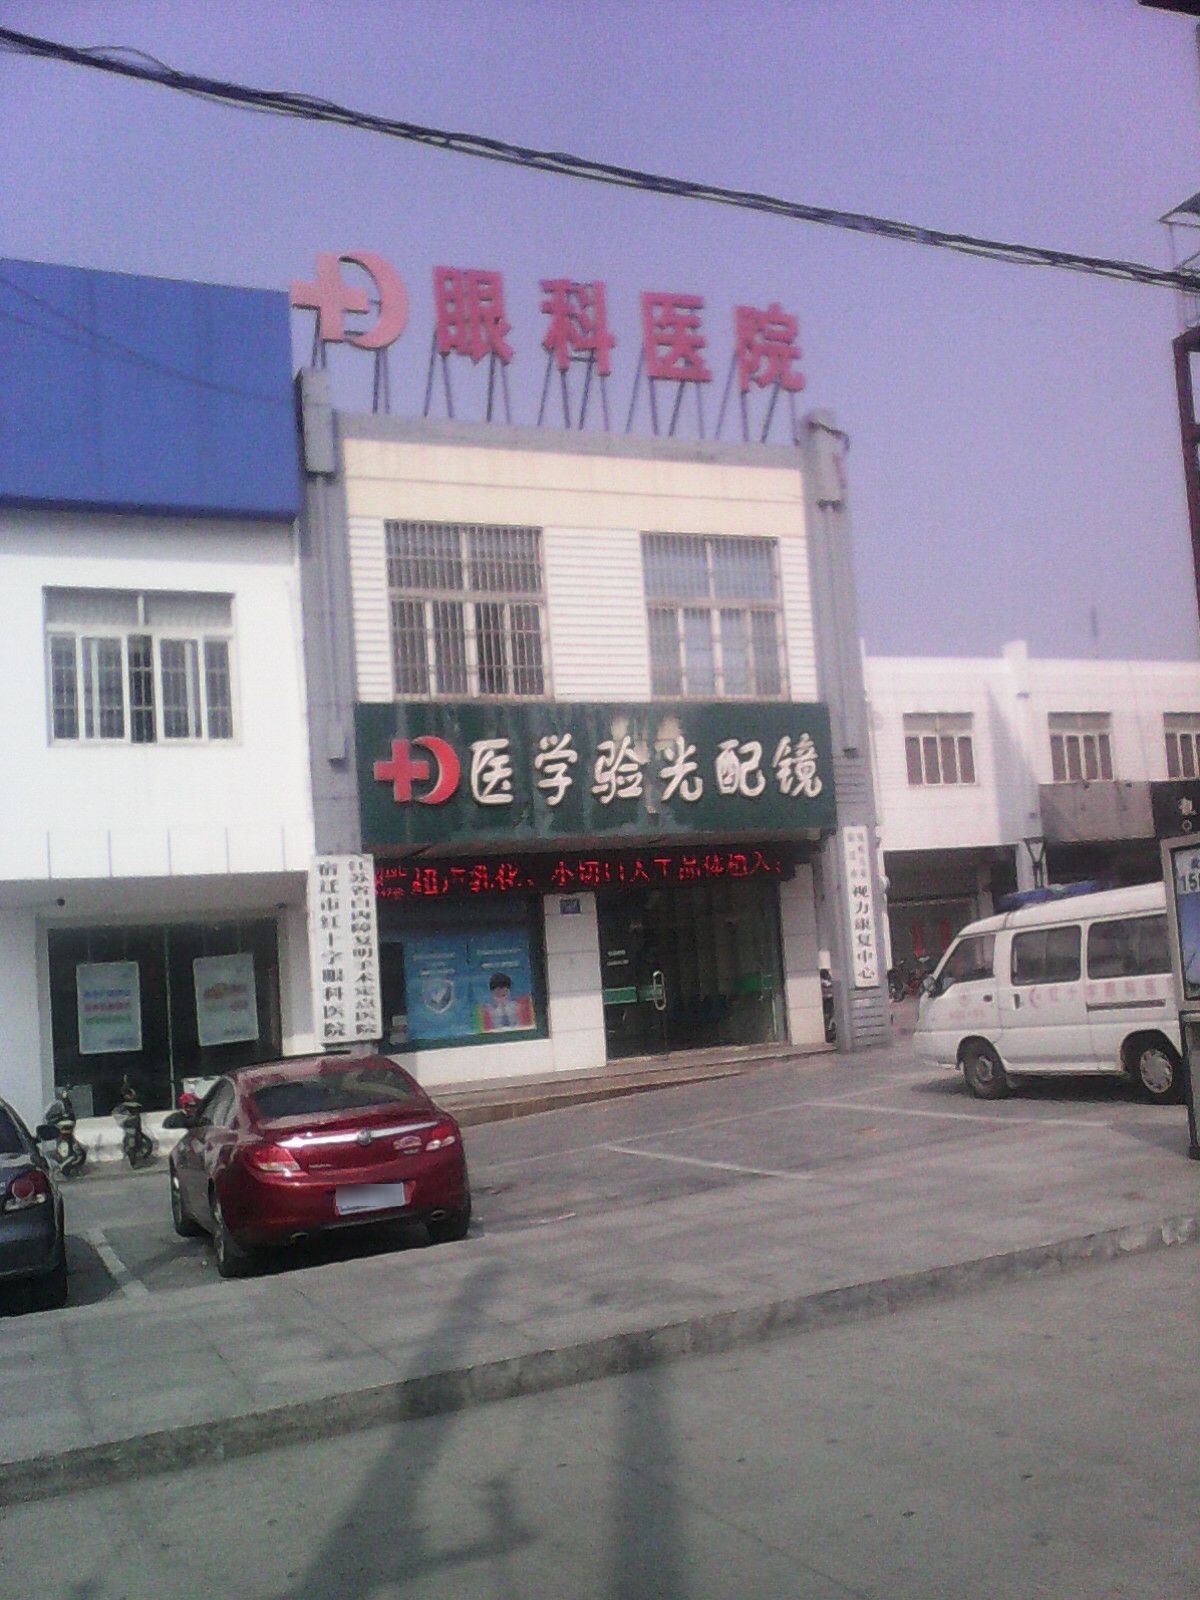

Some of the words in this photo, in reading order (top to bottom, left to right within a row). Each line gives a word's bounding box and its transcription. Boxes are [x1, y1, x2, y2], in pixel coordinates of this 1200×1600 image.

[432, 265, 805, 393] 眼科医院
[468, 732, 823, 806] 医学验光配镜
